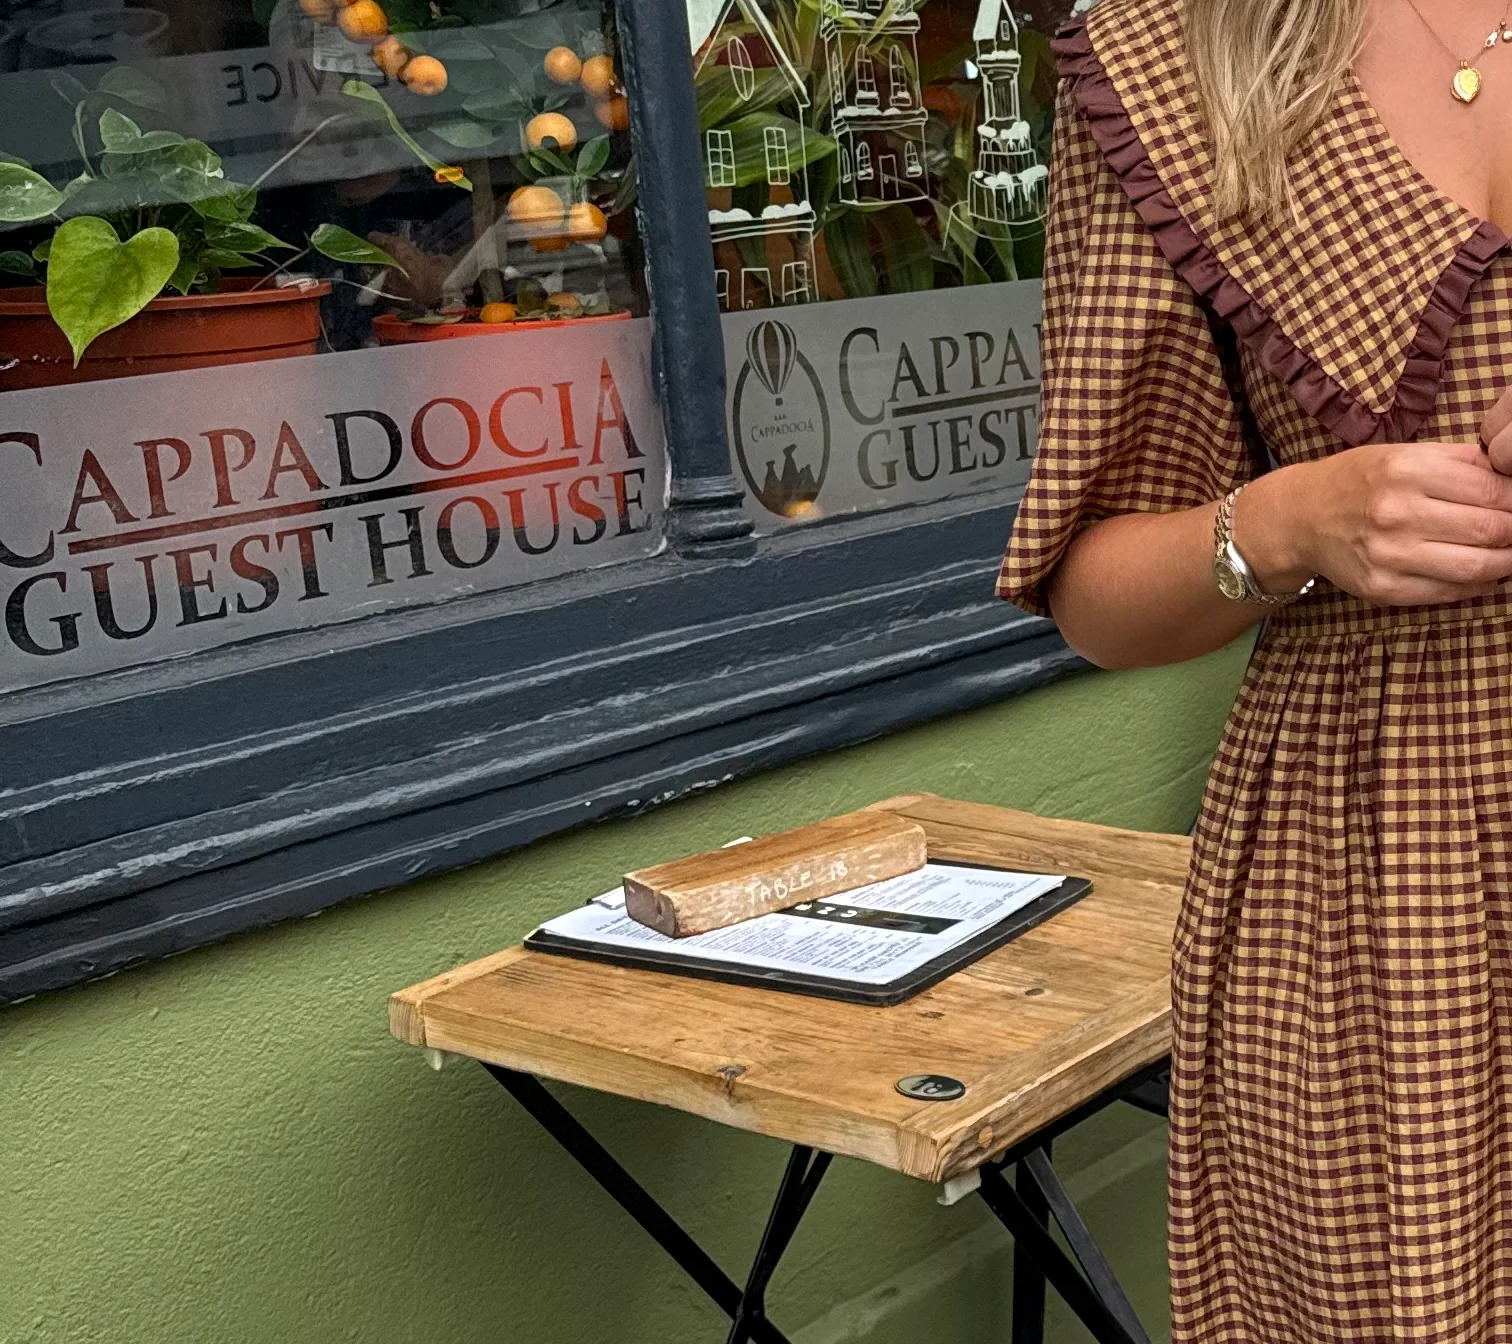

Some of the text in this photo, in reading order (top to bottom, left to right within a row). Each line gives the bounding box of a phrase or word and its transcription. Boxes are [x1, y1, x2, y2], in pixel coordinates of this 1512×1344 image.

[839, 323, 1042, 425] CAPPA
[751, 419, 815, 443] CAPPADOCIA
[857, 403, 1037, 490] GUEST
[4, 467, 653, 657] GUEST HOUSE
[744, 870, 814, 906] TABLE
